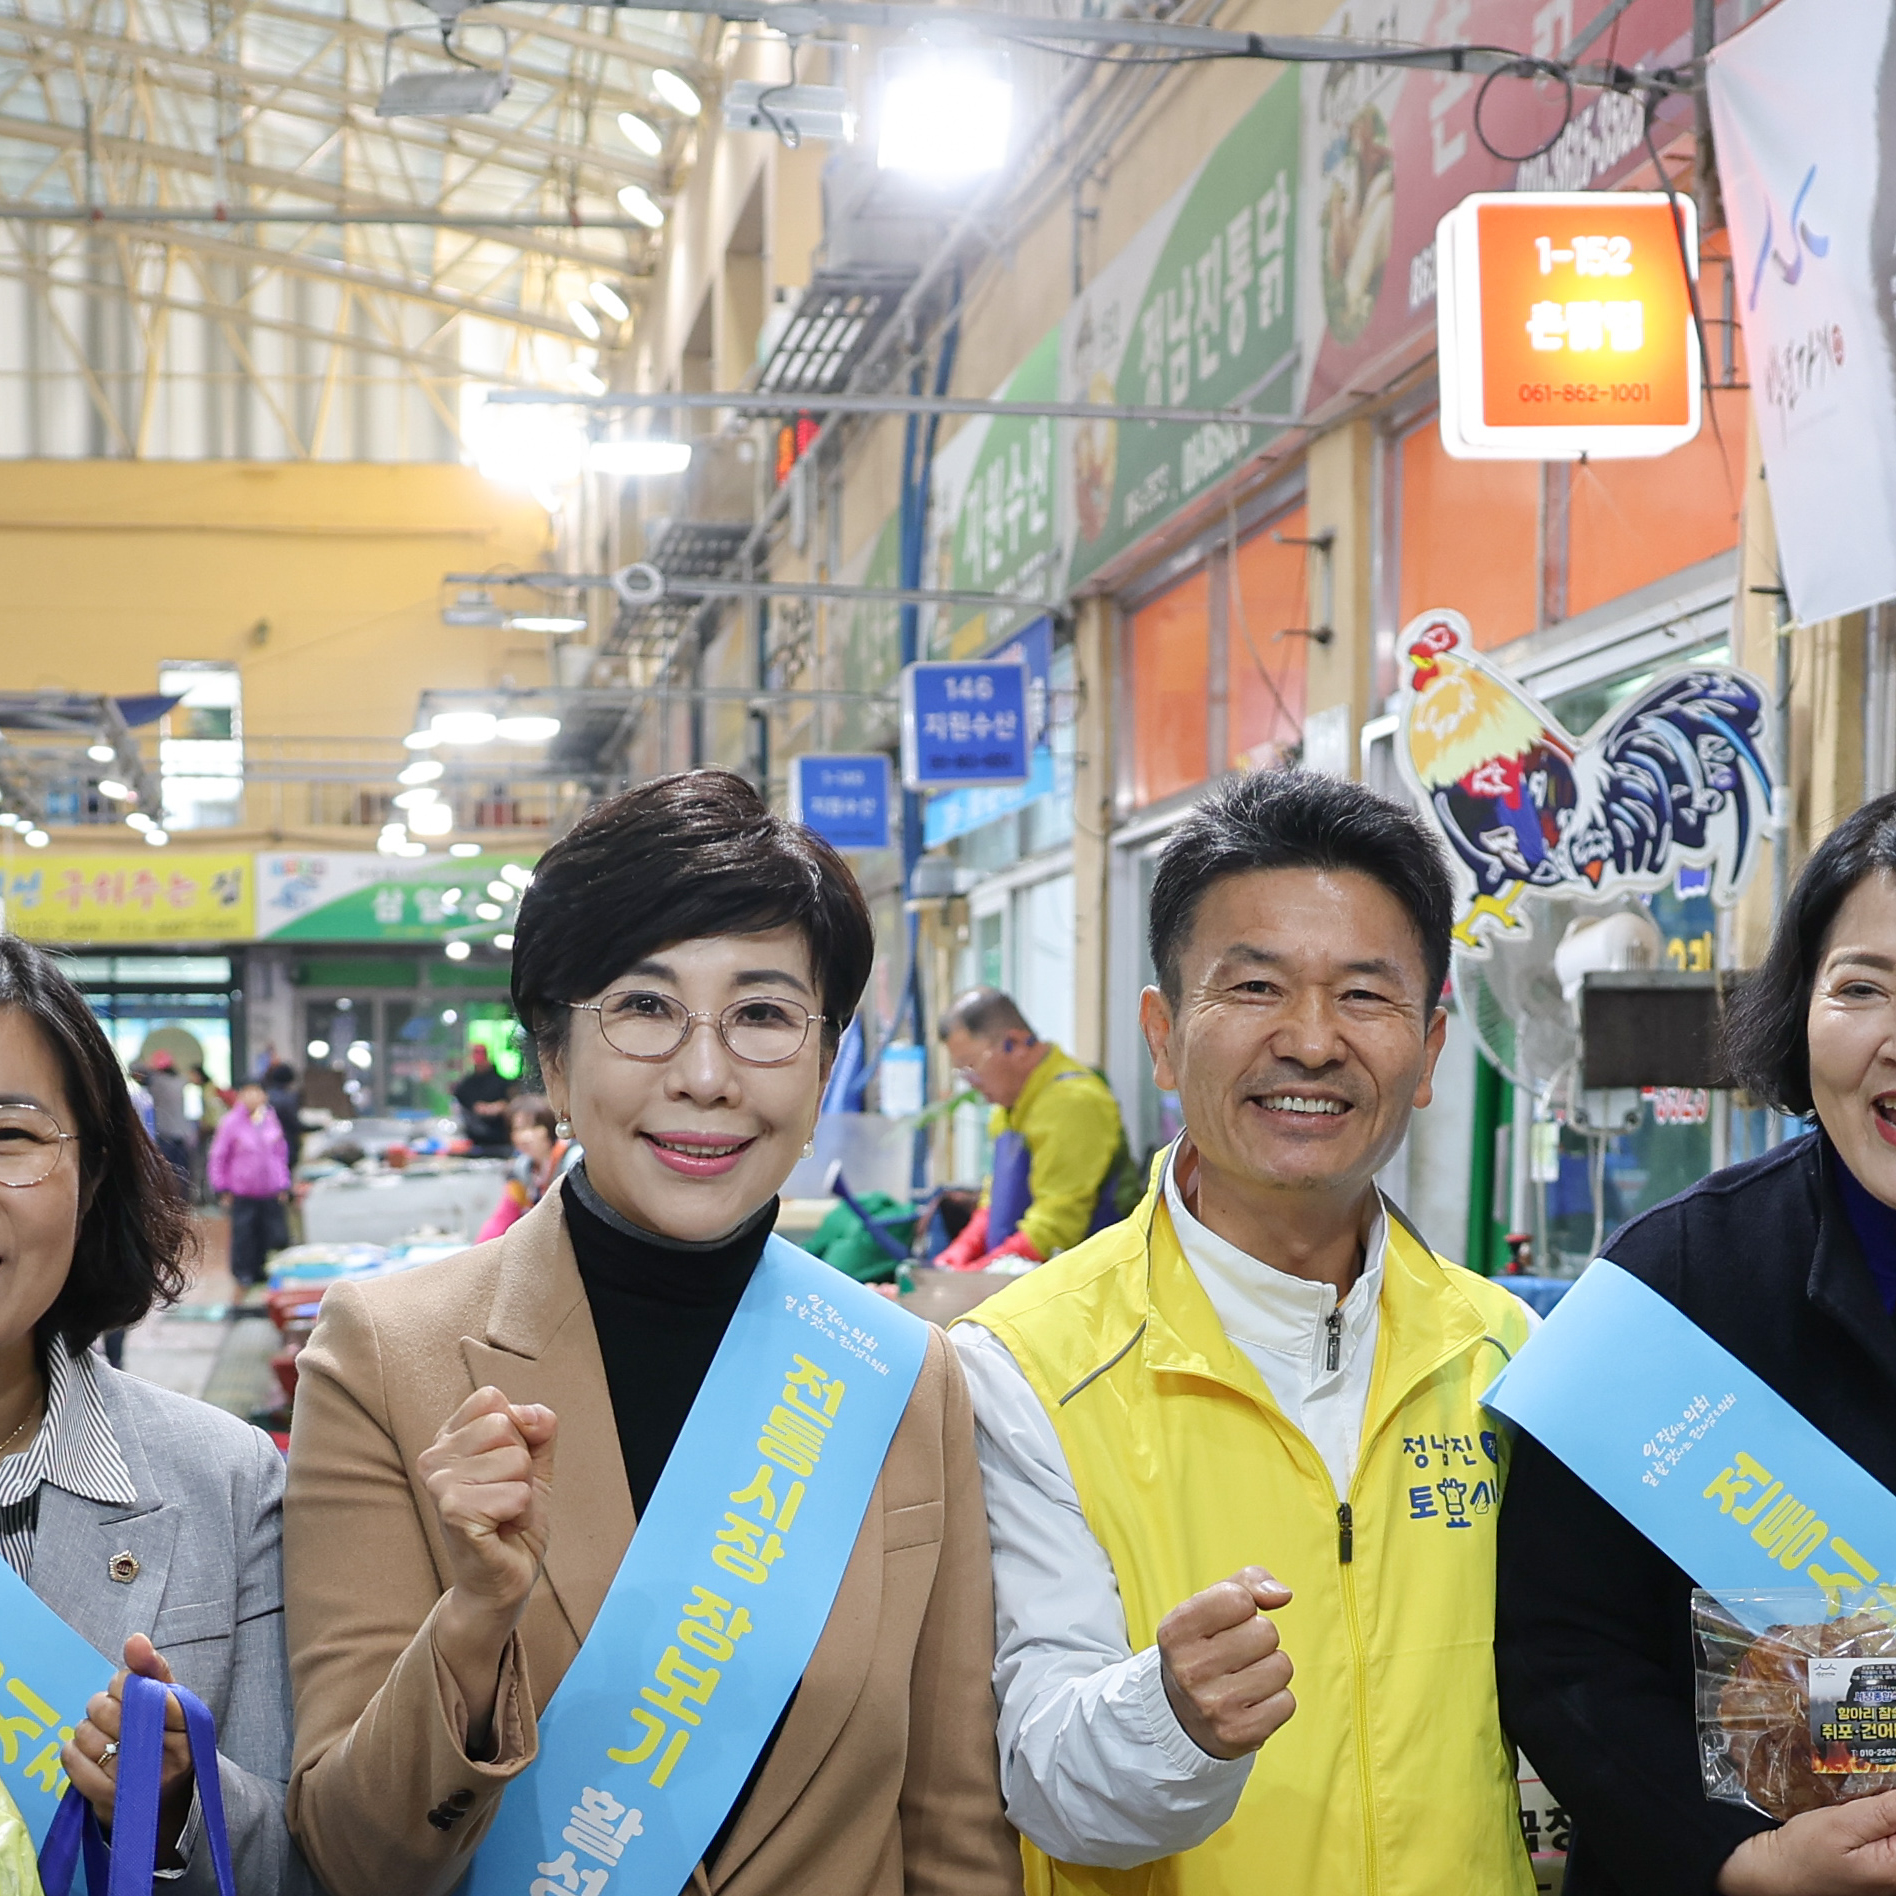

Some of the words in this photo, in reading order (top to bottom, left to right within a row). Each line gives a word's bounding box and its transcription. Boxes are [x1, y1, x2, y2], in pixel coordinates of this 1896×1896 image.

[1535, 235, 1632, 276] 1-152
[1140, 169, 1291, 429] 정남진통닭
[1519, 383, 1650, 402] 061-862-1001
[945, 676, 994, 701] 146
[1403, 1433, 1477, 1468] 정남진
[714, 1355, 845, 1586] 전통시장
[606, 1584, 753, 1790] 장보기
[1837, 1705, 1875, 1721] 항아리
